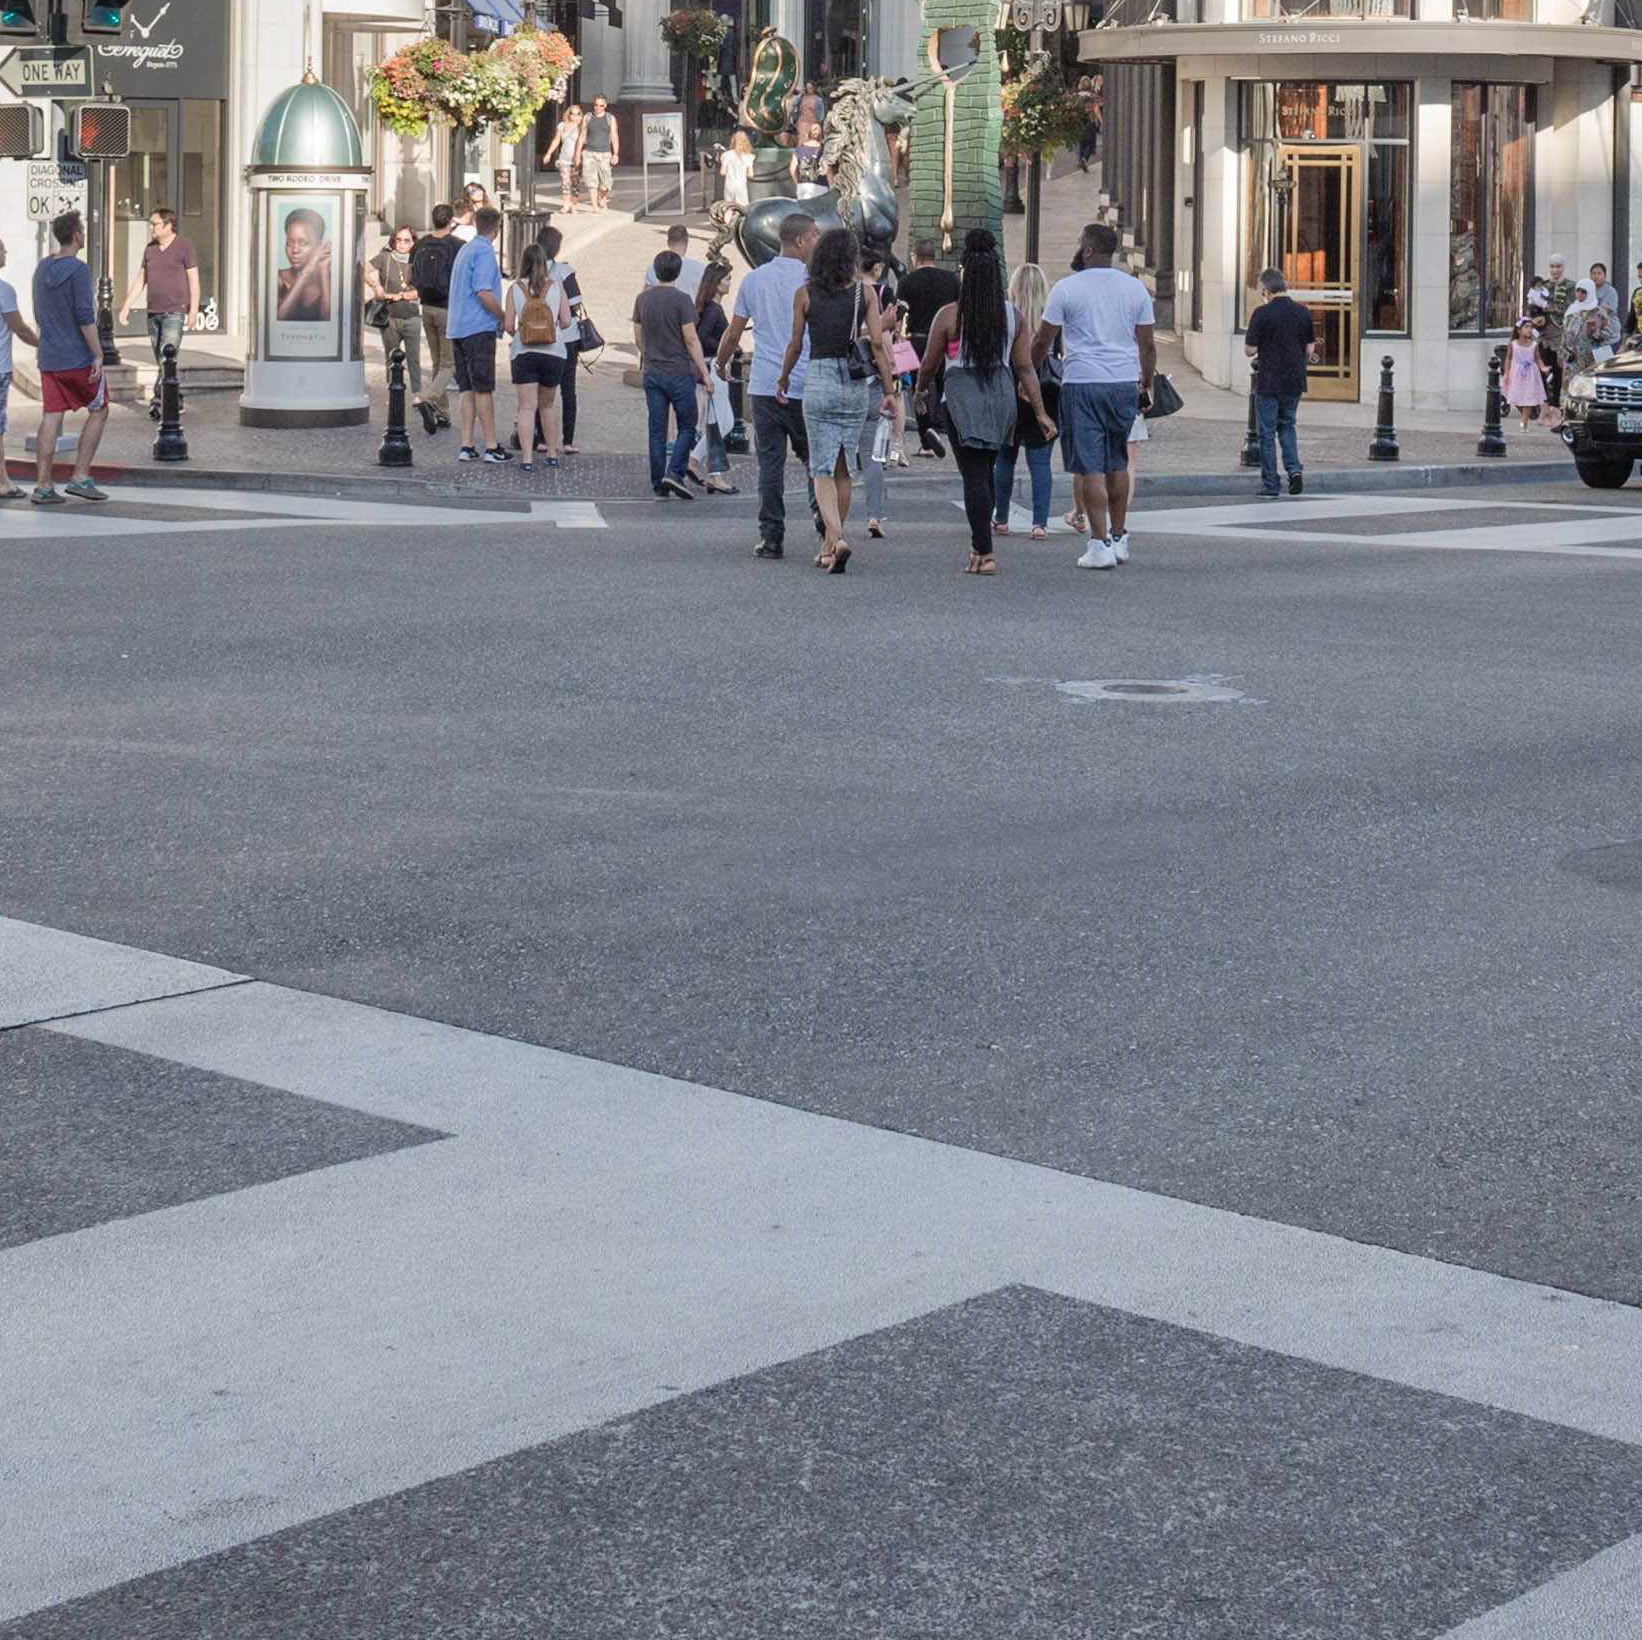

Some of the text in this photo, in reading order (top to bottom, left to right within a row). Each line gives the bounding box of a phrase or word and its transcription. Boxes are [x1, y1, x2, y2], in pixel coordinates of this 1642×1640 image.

[1259, 32, 1340, 44] STEFANO RICCI
[23, 62, 81, 81] ONE WAY
[30, 163, 83, 176] DIAGONAL
[30, 178, 84, 189] CROSSING
[268, 175, 342, 184] TWO RODEO DRIVE
[30, 195, 50, 214] OK
